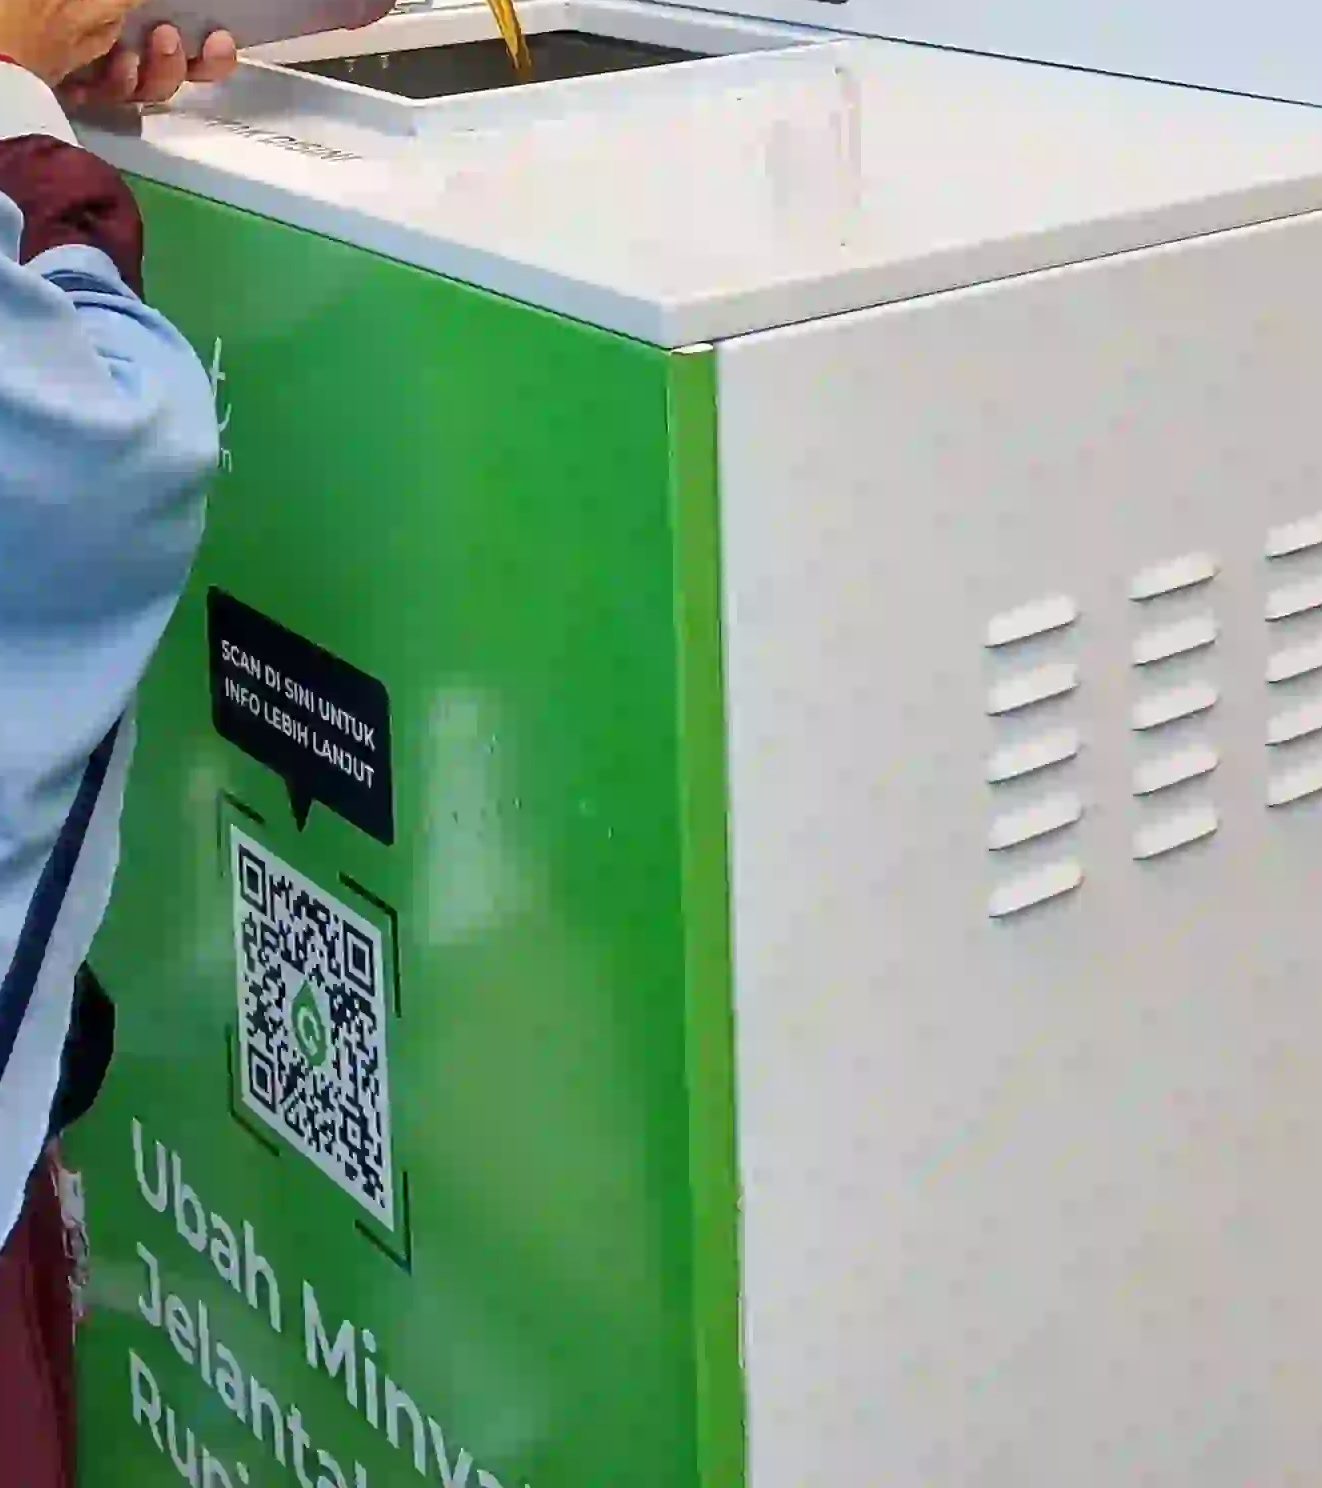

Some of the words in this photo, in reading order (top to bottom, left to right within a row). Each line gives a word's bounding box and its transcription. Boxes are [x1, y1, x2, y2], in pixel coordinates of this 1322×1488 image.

[221, 640, 261, 680] SCAN
[265, 665, 281, 692] DI
[284, 678, 314, 712] SINI
[318, 697, 375, 752] UNTUK
[225, 676, 261, 716] INFO
[264, 701, 308, 748] LEBIH
[312, 731, 375, 788] LANJUT
[132, 1116, 281, 1333] Ubah
[303, 1279, 532, 1488] Miny
